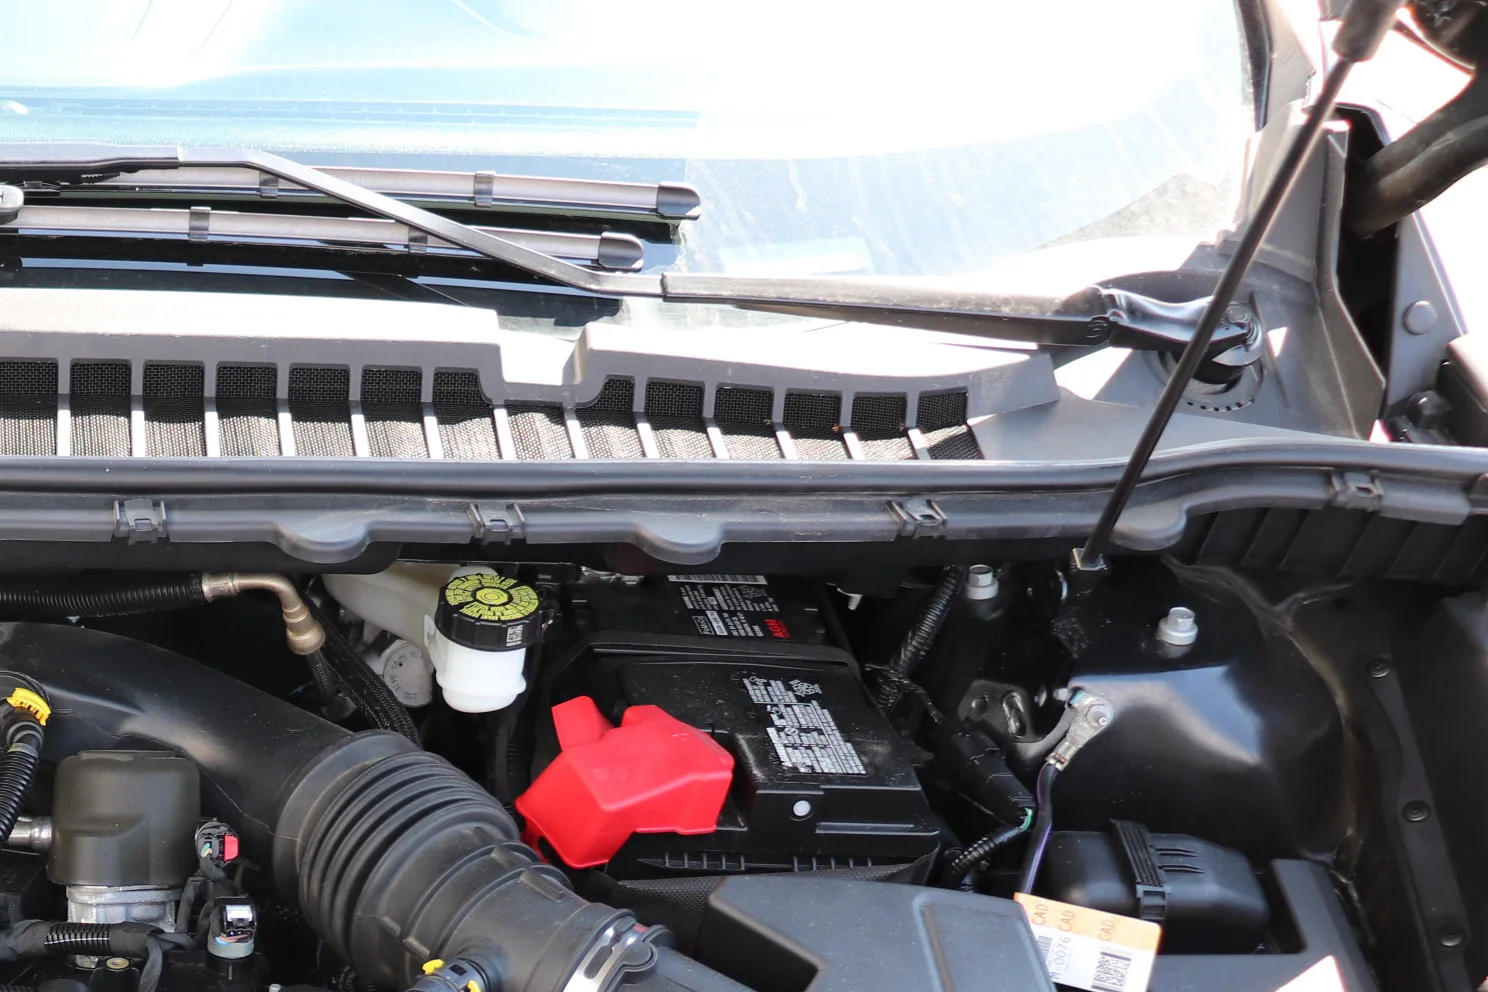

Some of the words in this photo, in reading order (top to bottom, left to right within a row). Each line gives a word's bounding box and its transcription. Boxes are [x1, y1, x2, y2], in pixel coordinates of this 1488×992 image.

[764, 619, 790, 638] AGM
[1032, 903, 1048, 925] CAD
[1058, 910, 1075, 932] CAD
[1097, 919, 1115, 941] CAD
